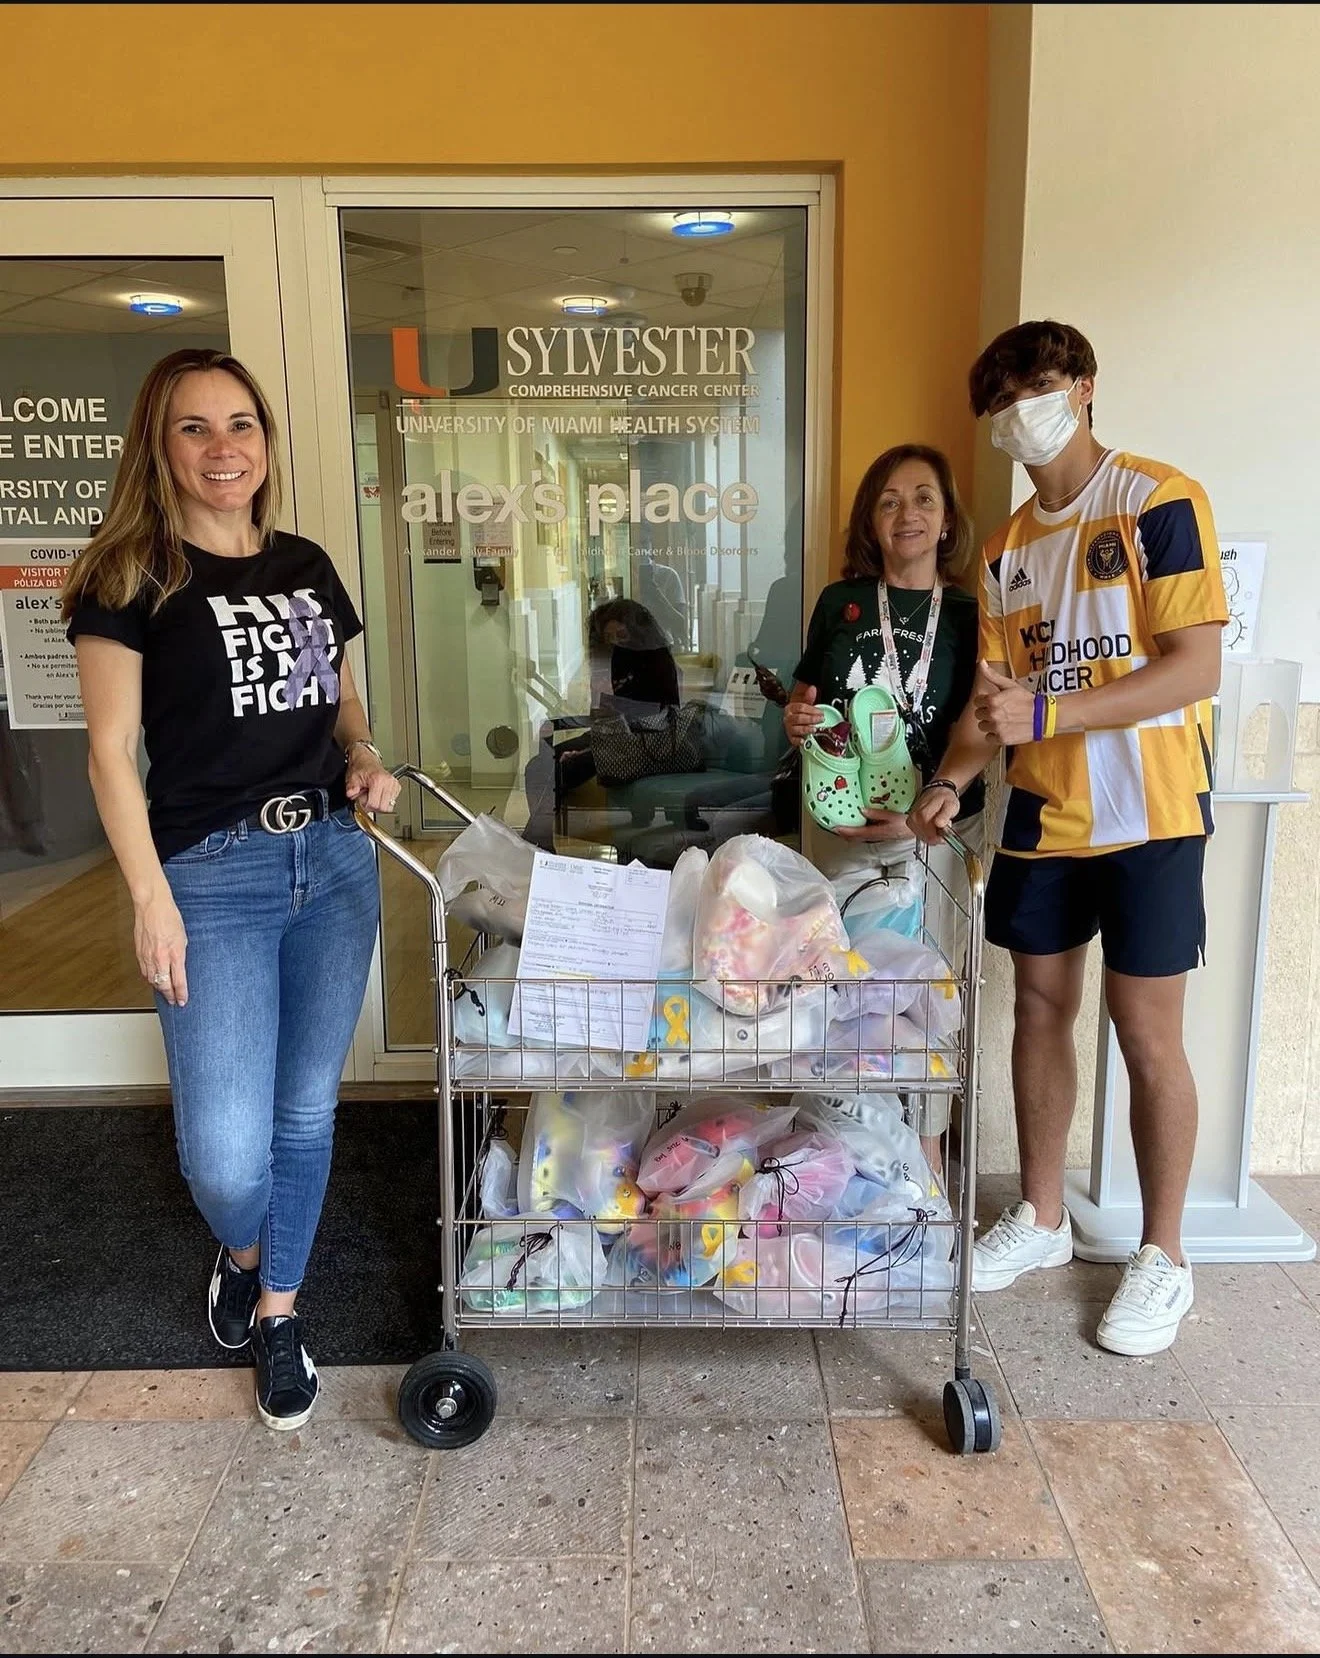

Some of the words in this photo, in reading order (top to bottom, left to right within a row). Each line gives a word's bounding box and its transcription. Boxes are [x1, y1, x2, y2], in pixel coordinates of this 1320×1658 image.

[506, 326, 760, 376] SYLVESTER
[508, 384, 633, 397] COMPREHENSIVE
[637, 384, 699, 397] CANCER
[704, 384, 760, 397] CENTER
[395, 415, 505, 434] UNIVERSITY
[513, 415, 536, 434] OF
[542, 415, 602, 434] MIAMI
[610, 415, 681, 434] HEALTH
[686, 415, 760, 434] SYSTEM
[24, 434, 124, 459] ENTER
[75, 480, 107, 499] OF
[401, 469, 568, 524] alex's
[588, 469, 760, 536] place
[54, 506, 104, 525] AND
[629, 546, 664, 556] Cancer
[20, 567, 60, 577] VISITOR
[14, 579, 44, 588] PÓLIZA
[1009, 579, 1032, 592] adidas
[15, 596, 63, 610] alex's
[892, 628, 925, 644] FRES
[230, 655, 265, 683] IS
